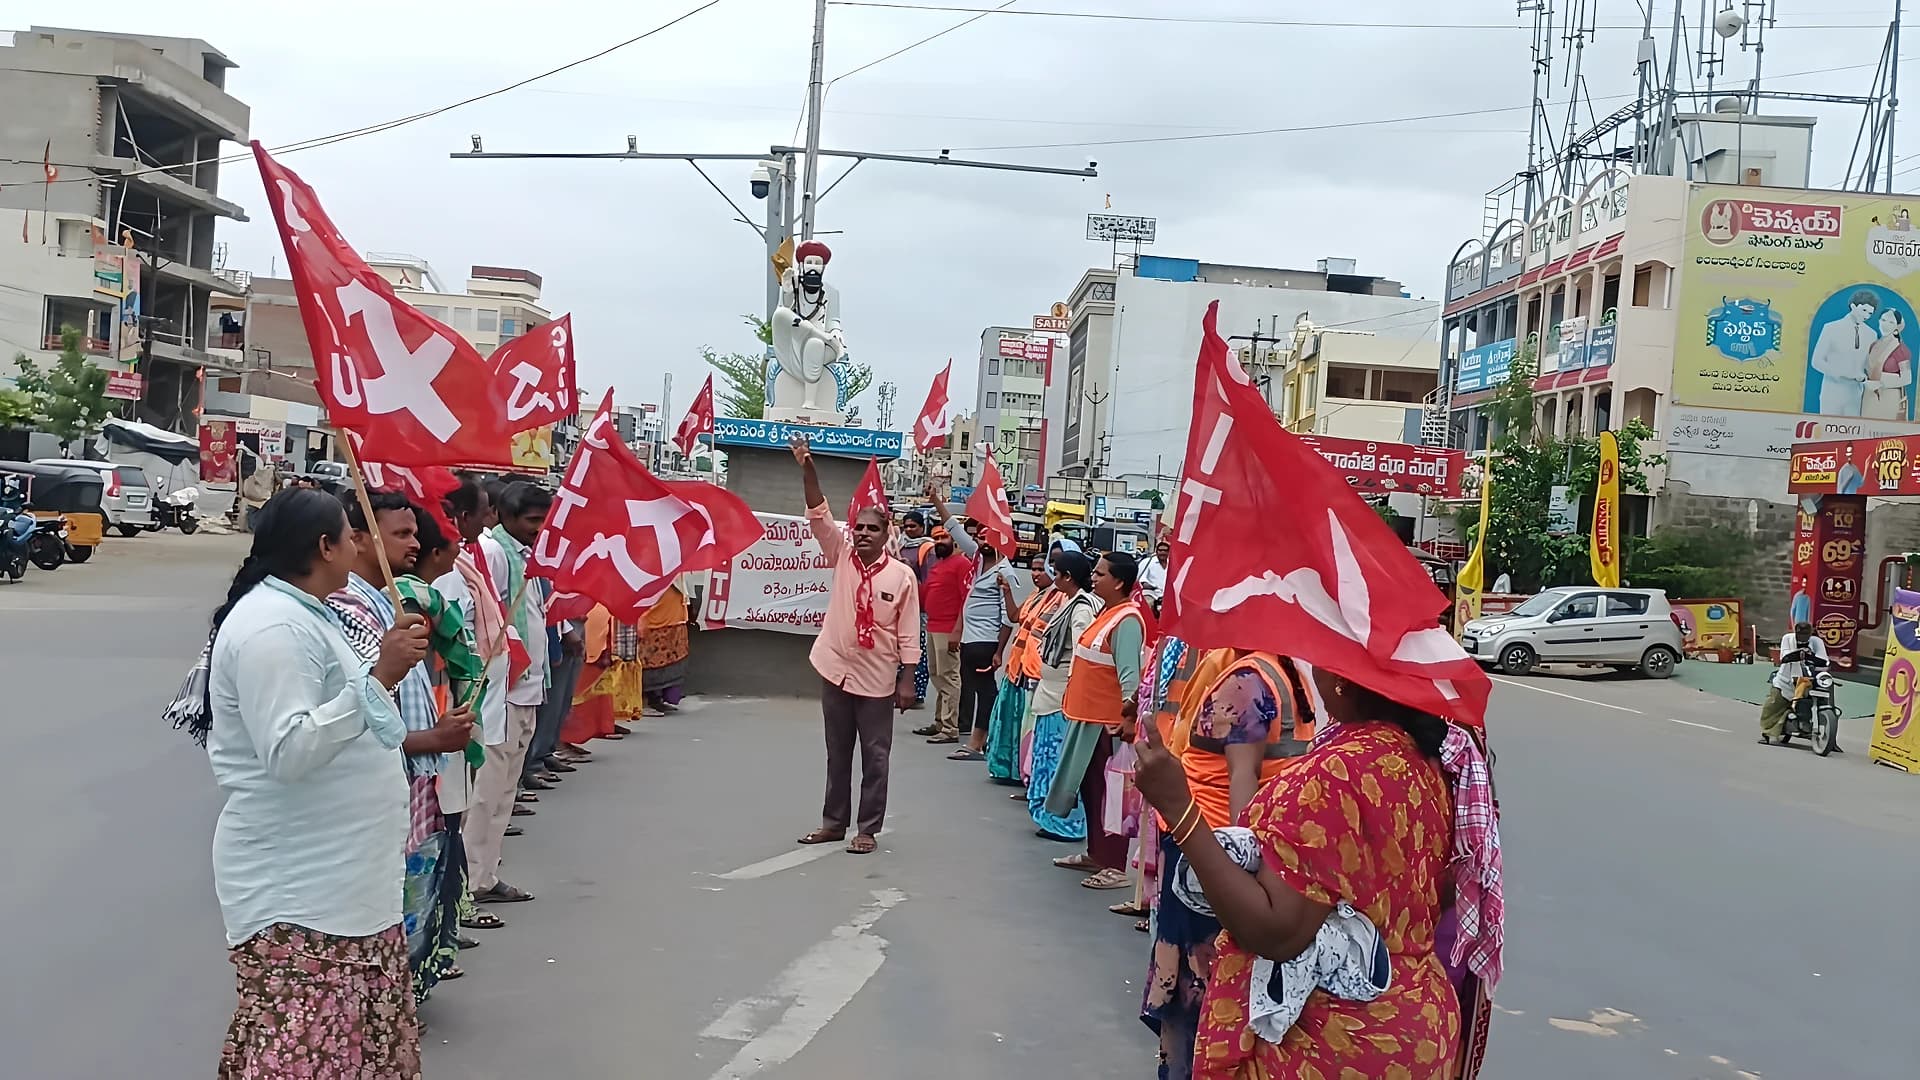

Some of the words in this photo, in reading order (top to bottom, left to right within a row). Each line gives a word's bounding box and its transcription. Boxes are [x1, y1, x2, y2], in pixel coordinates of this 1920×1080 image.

[1036, 318, 1071, 329] SATH
[714, 423, 738, 440] ద్గురు
[875, 437, 900, 450] గారు
[1879, 461, 1902, 480] KG
[534, 411, 610, 569] CITU
[708, 571, 729, 621] TU
